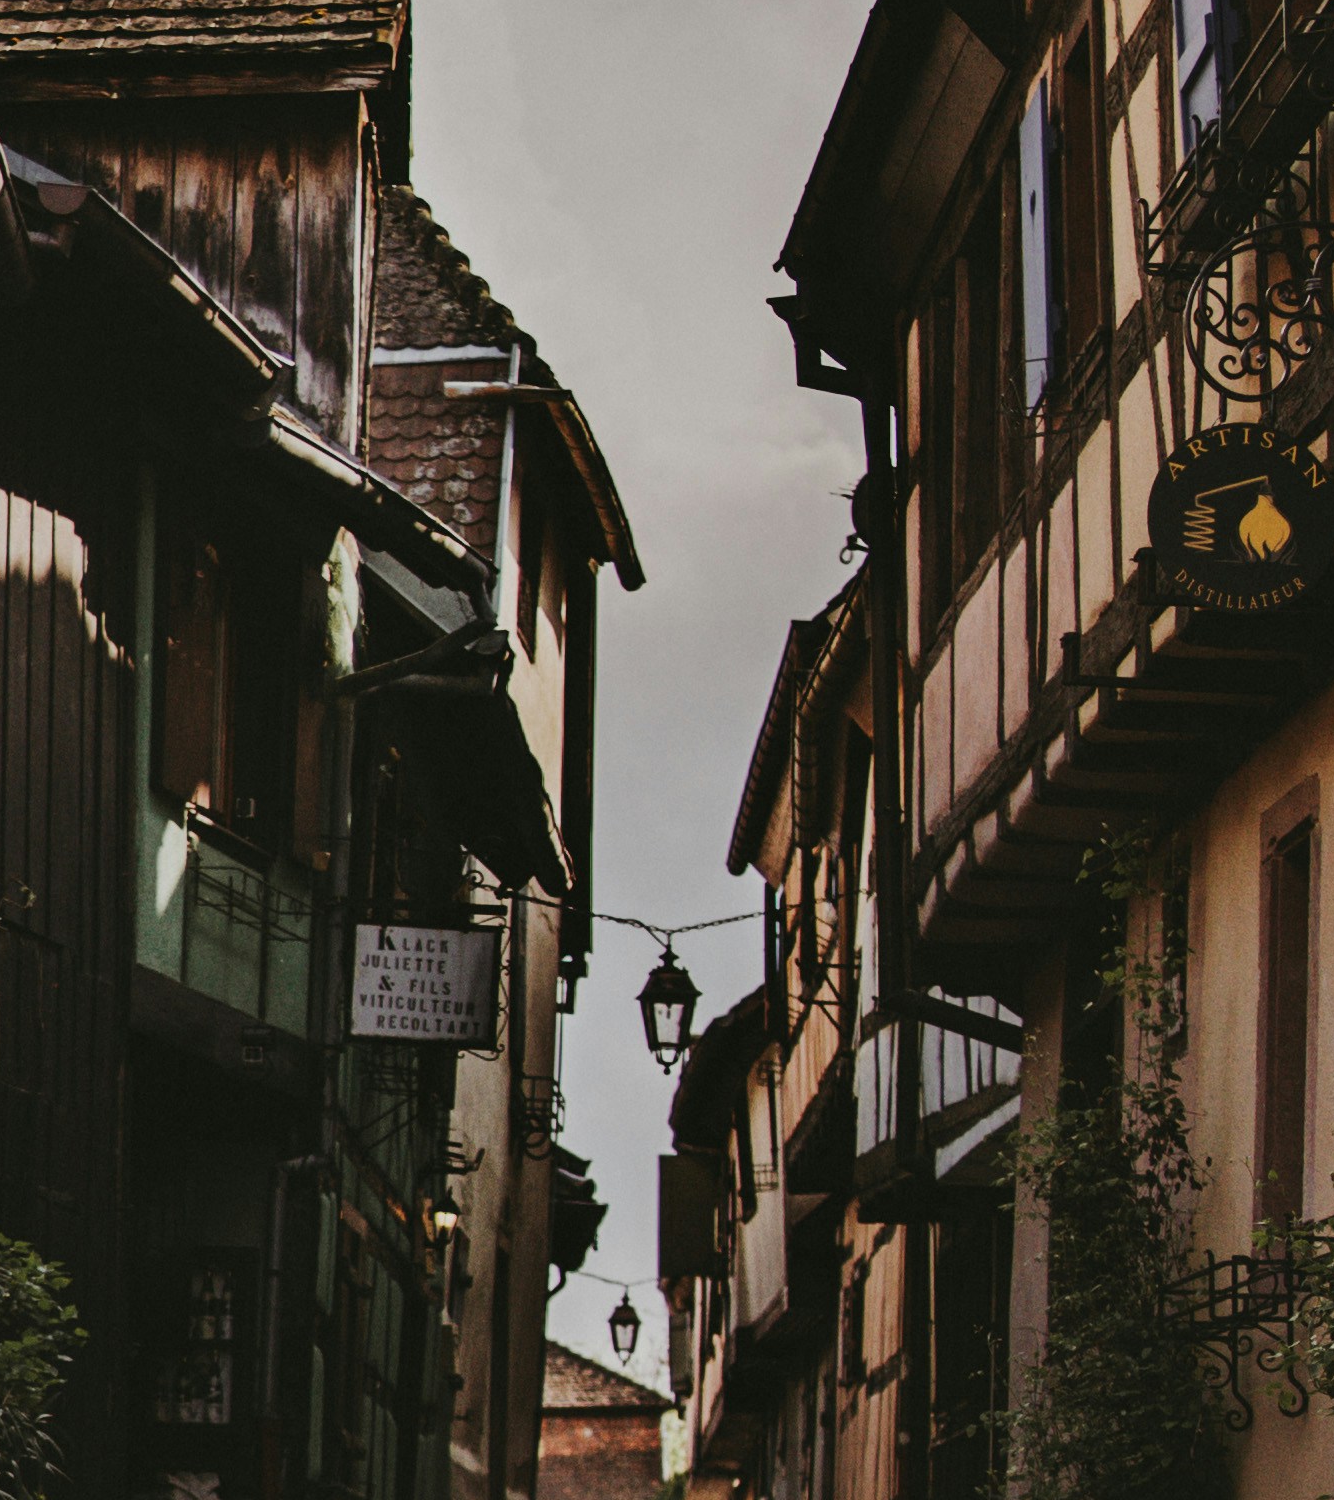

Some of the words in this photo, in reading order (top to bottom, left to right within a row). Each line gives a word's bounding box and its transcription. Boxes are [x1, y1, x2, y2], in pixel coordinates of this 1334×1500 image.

[1167, 427, 1328, 489] ARTISAN
[1174, 568, 1307, 611] DISTILLATEUR
[377, 928, 449, 954] KLACK
[361, 954, 446, 975] JULIETTE
[378, 975, 395, 991] &
[409, 979, 452, 996] FILS
[360, 994, 475, 1016] VITICULTEUR
